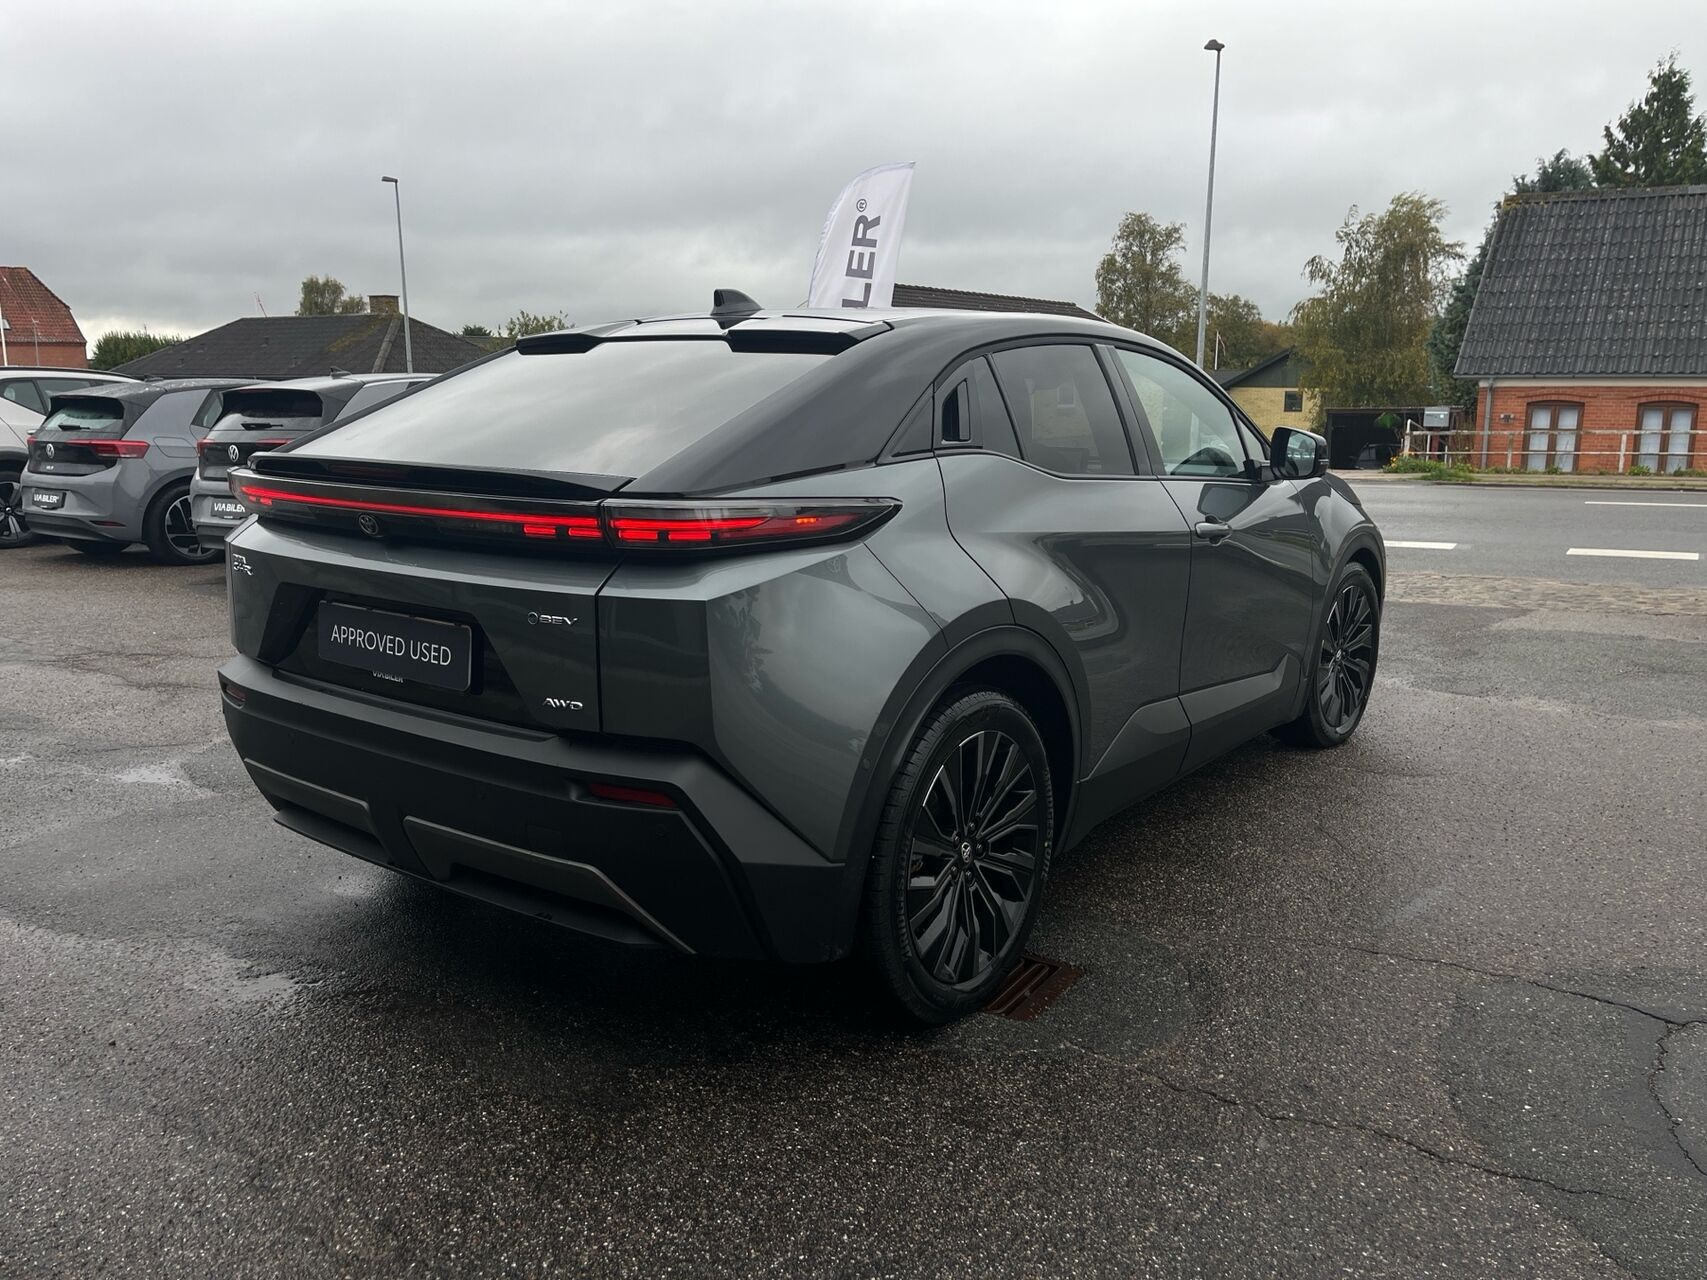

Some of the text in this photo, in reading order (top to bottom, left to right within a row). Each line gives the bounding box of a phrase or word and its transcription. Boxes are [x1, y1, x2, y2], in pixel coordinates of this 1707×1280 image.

[330, 624, 452, 667] APPROVED USED
[542, 697, 583, 710] AWD
